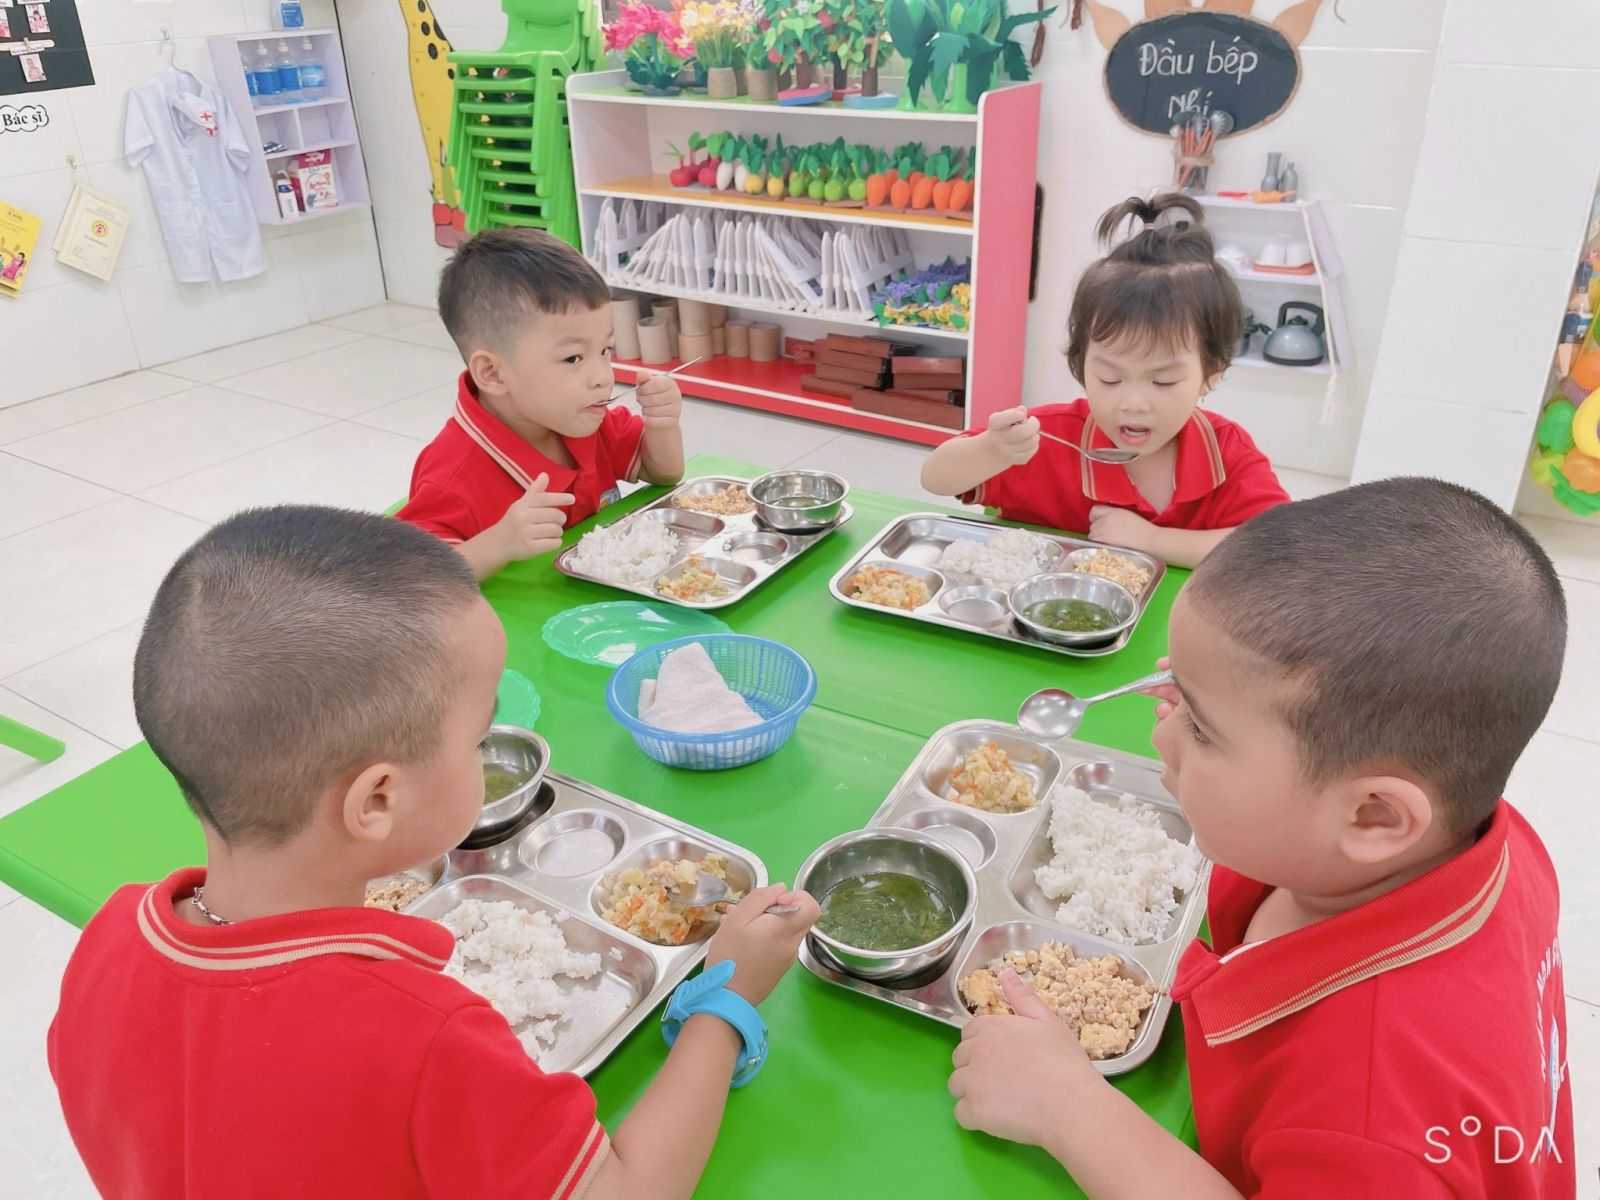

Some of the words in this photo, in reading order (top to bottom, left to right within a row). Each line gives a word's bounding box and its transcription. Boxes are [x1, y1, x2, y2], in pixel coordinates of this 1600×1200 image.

[1138, 38, 1195, 77] Đầu
[1206, 35, 1259, 86] bếp
[2, 112, 28, 126] Bác
[31, 111, 43, 124] sĩ
